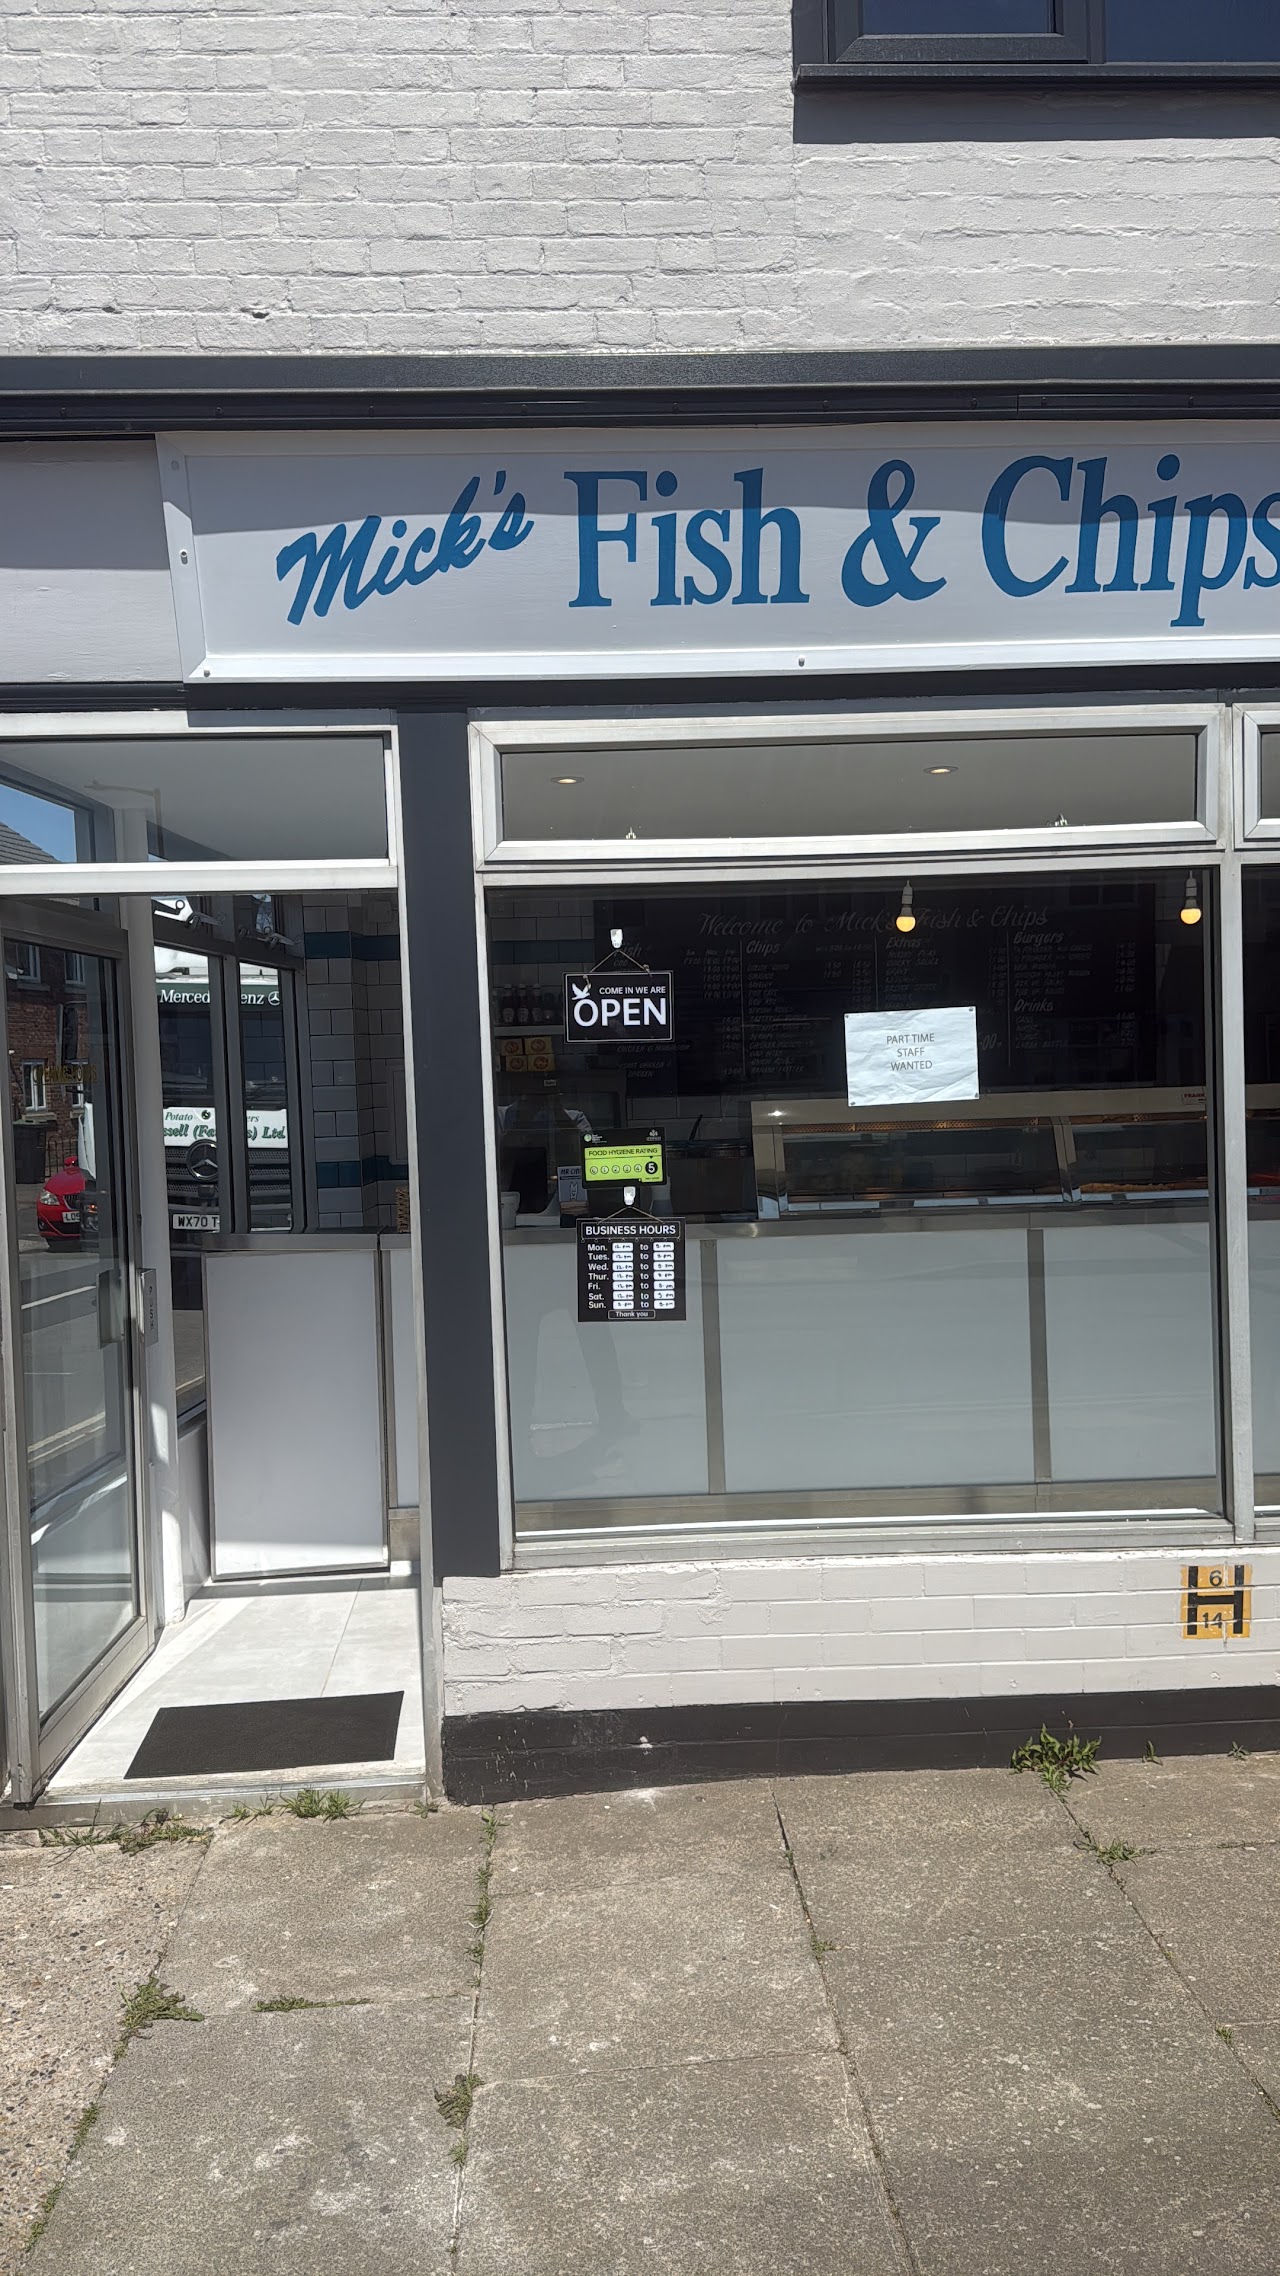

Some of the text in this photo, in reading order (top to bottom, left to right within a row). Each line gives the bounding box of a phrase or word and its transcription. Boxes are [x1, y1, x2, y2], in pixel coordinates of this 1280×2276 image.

[276, 454, 1280, 627] Mick's Fish & Chips
[698, 912, 783, 936] Welcome
[795, 913, 813, 934] to
[966, 909, 984, 928] &
[990, 904, 1048, 931] Chips
[885, 936, 921, 949] Extras
[1013, 932, 1065, 947] Burgers
[746, 940, 780, 957] Chips
[599, 986, 666, 995] COME IN WE ARE
[1013, 998, 1054, 1012] Drinks
[573, 997, 666, 1027] OPEN
[886, 1033, 935, 1045] PART TIME
[897, 1047, 925, 1058] STAFF
[890, 1060, 933, 1071] WANTED
[165, 1112, 193, 1121] Potato
[163, 1124, 189, 1137] ssell
[262, 1126, 286, 1139] Ltd
[648, 1163, 655, 1173] 5
[178, 1216, 207, 1227] WX70
[586, 1225, 676, 1235] BUSINESS HOURS
[588, 1282, 600, 1290] Fri.
[588, 1301, 606, 1309] Sun.
[636, 1311, 648, 1319] you
[1209, 1570, 1222, 1587] 6
[1202, 1612, 1222, 1629] 14
